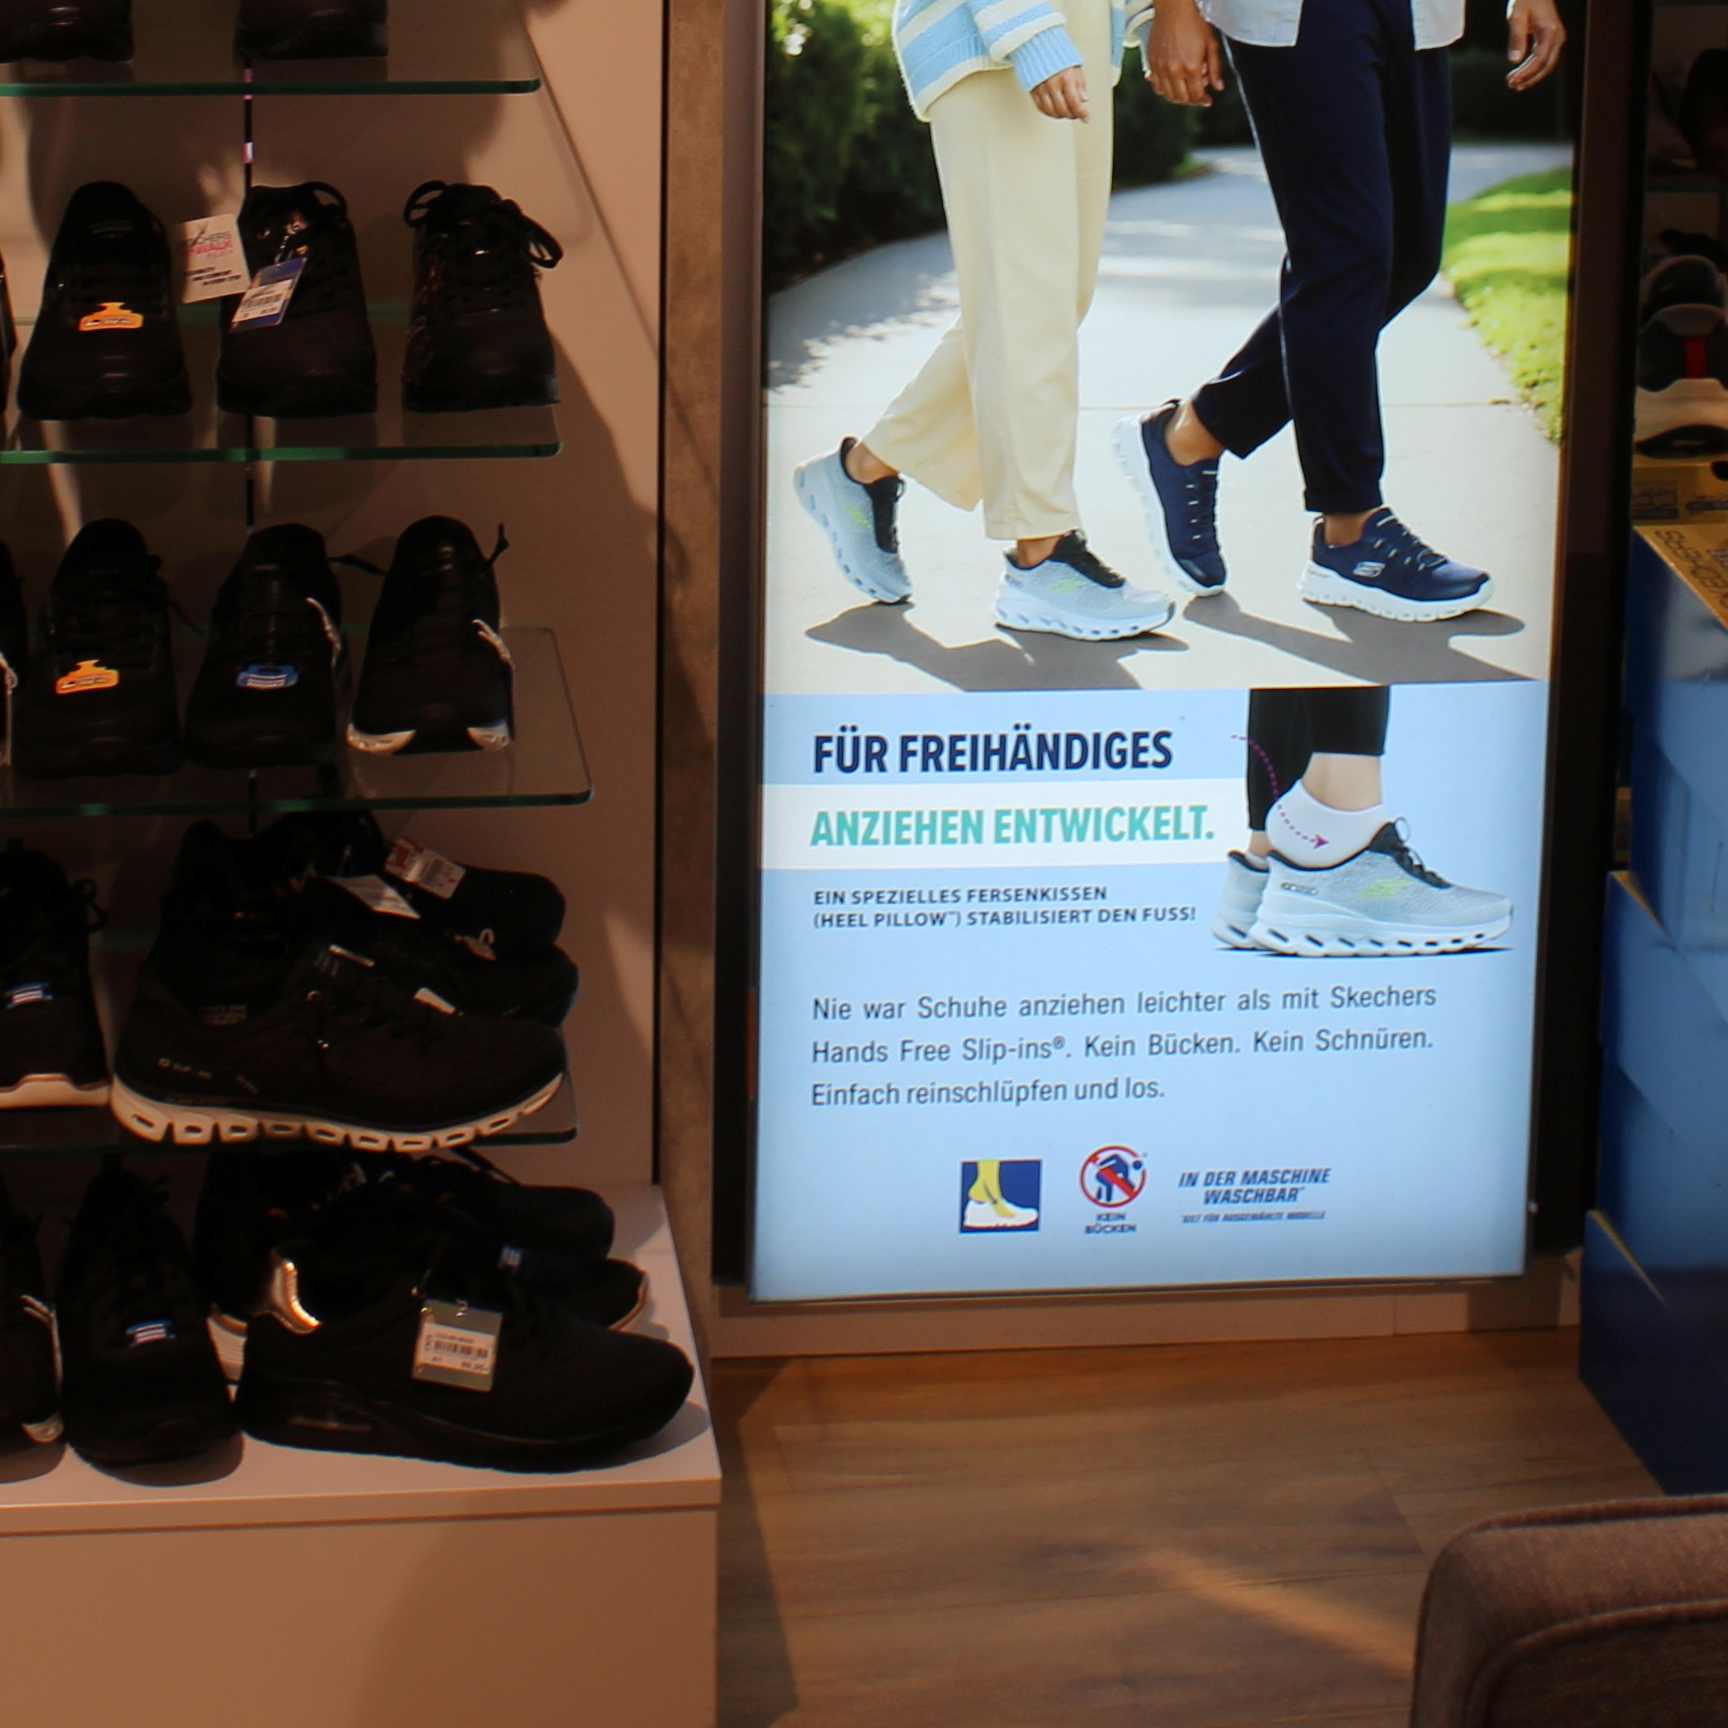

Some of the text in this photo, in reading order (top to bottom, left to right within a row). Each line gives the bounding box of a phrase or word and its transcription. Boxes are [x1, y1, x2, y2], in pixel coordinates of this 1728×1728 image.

[813, 723, 1173, 774] FÜR FREIHÄNDIGES
[810, 804, 1215, 847] ANZIEHEN ENTWICKELT.
[814, 885, 1108, 906] EIN SPEZIELLES FERSENKISSEN
[813, 911, 869, 930] (HEEL
[966, 907, 1092, 926] STABILISIERT
[1097, 908, 1139, 924] DEN
[1142, 906, 1197, 923] FUSS!
[812, 984, 1438, 1021] Nie war Schuhe anziehen leichter als mit Skechers
[811, 1039, 889, 1064] Hands
[900, 1038, 952, 1063] Free
[1083, 1031, 1136, 1058] Kein
[1147, 1031, 1242, 1057] Bücken.
[1252, 1029, 1305, 1054] Kein
[1314, 1026, 1434, 1052] Schnüren.
[811, 1075, 1166, 1108] Einfach reinschlüpfen und los.
[1178, 1167, 1332, 1188] IN DER MASCHINE
